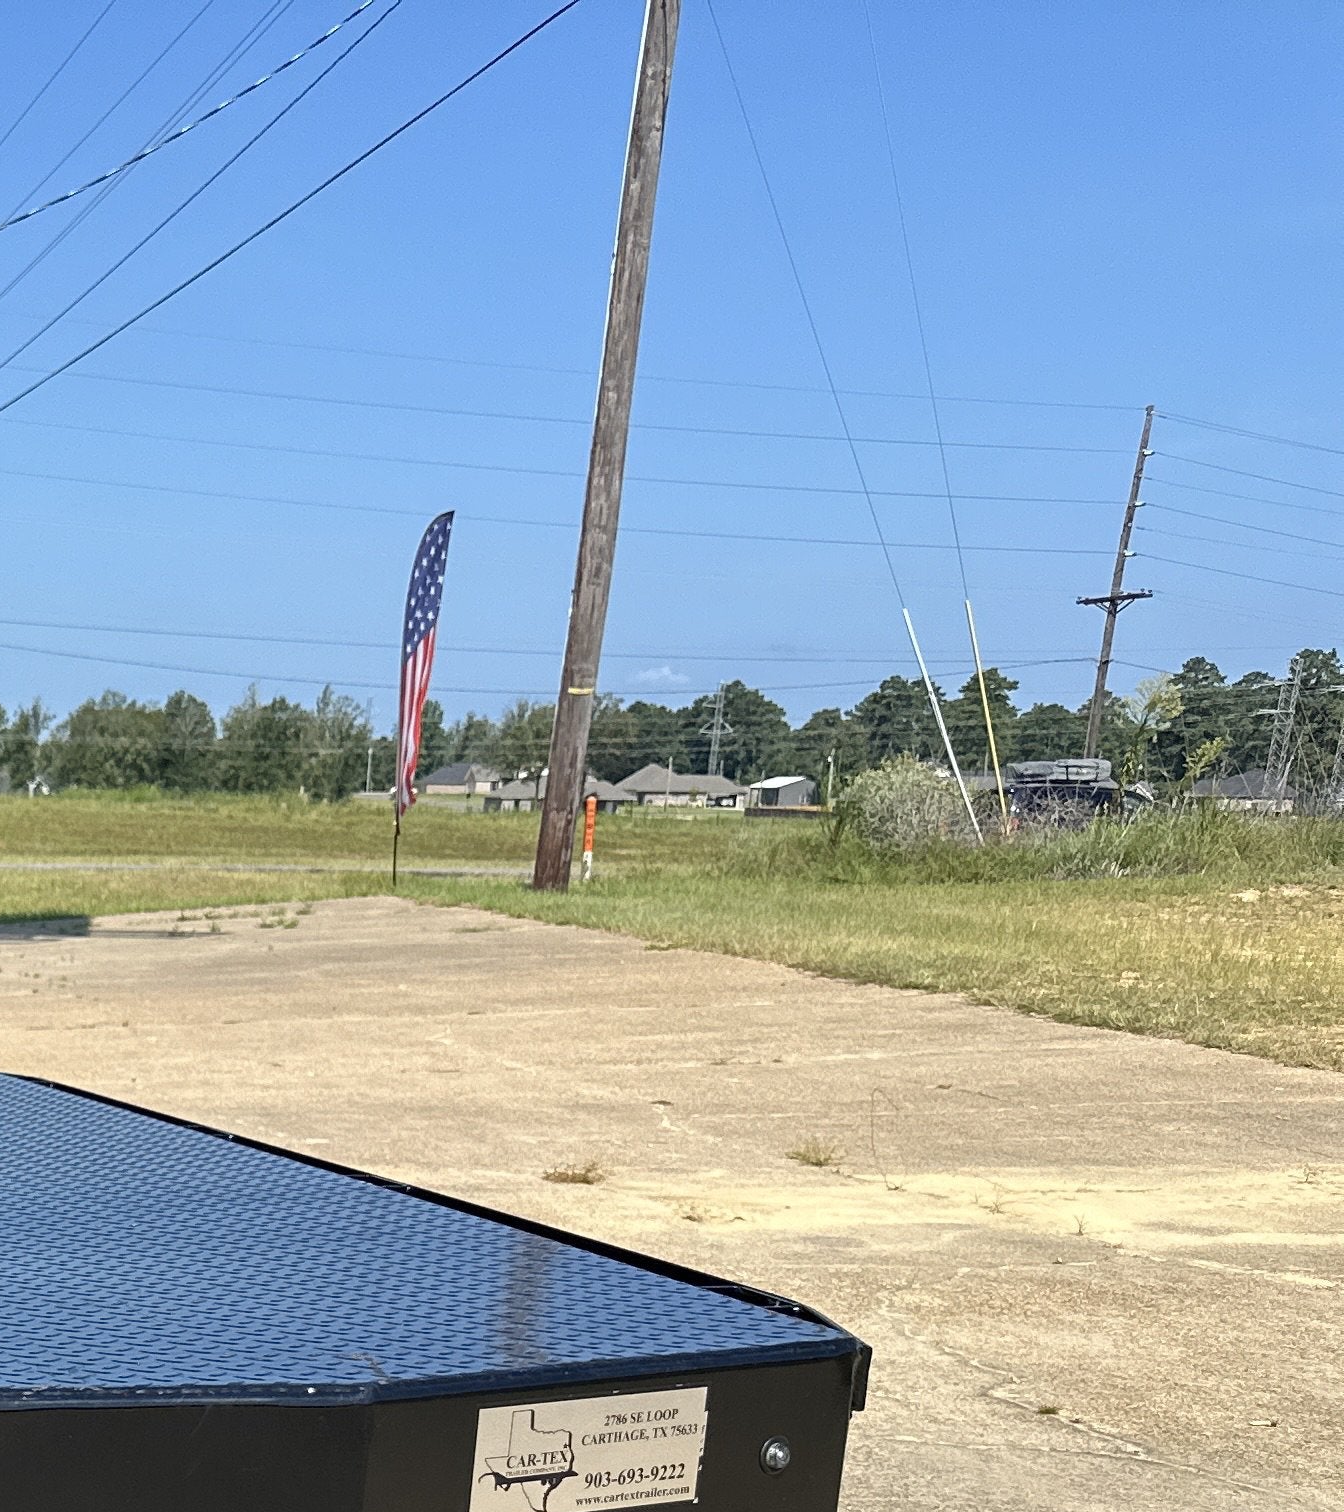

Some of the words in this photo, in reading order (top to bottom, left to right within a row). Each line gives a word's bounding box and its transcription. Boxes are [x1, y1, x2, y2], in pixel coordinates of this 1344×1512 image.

[604, 1413, 627, 1426] 2786
[630, 1411, 644, 1424] SE
[647, 1408, 679, 1422] LOOP
[581, 1428, 650, 1446] CARTHAGE,
[652, 1426, 668, 1439] TX
[670, 1423, 698, 1437] 75633
[506, 1450, 569, 1469] CAR-TEX
[584, 1462, 685, 1489] 903-693-9222
[575, 1485, 690, 1506] www.cartextrailer.com
